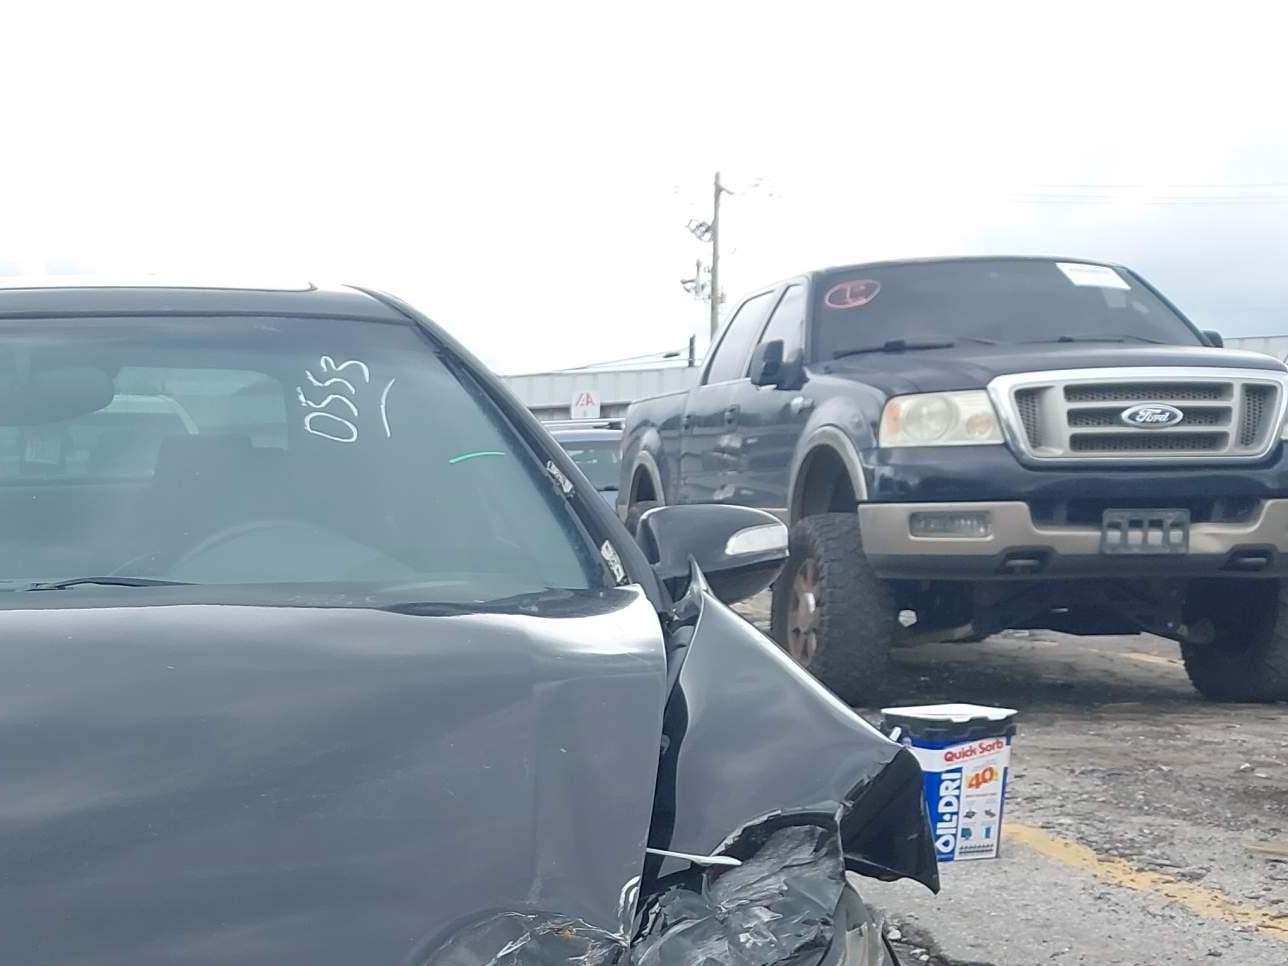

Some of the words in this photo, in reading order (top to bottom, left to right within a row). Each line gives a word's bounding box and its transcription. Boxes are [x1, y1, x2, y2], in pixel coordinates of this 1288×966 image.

[1135, 408, 1171, 422] Ford
[943, 748, 976, 762] Quick
[977, 738, 1004, 753] Sorb
[967, 766, 996, 790] 40
